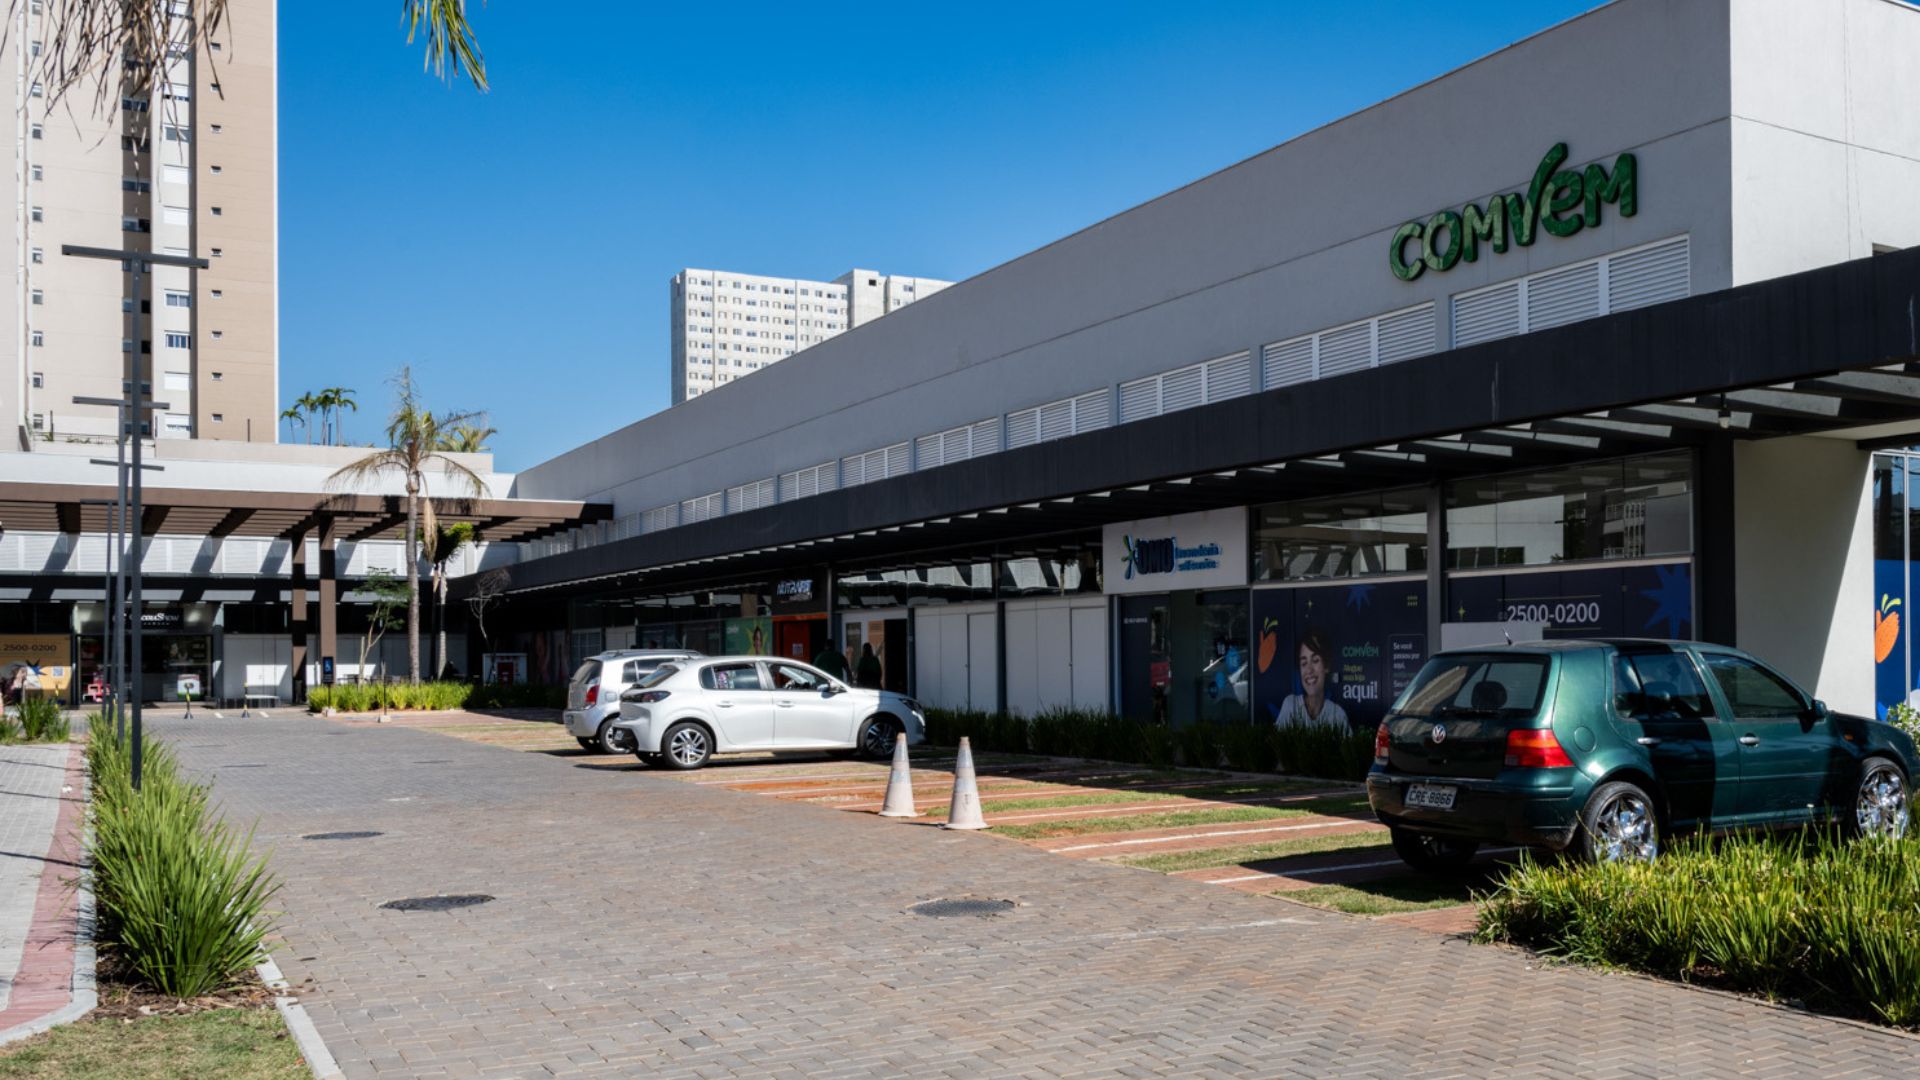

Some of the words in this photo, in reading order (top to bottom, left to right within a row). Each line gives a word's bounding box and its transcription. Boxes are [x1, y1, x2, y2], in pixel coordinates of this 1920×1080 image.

[1135, 537, 1175, 574] OMO
[1506, 602, 1601, 623] 2500-0200
[3, 643, 57, 652] 2500-0200
[1343, 681, 1378, 703] aqui!
